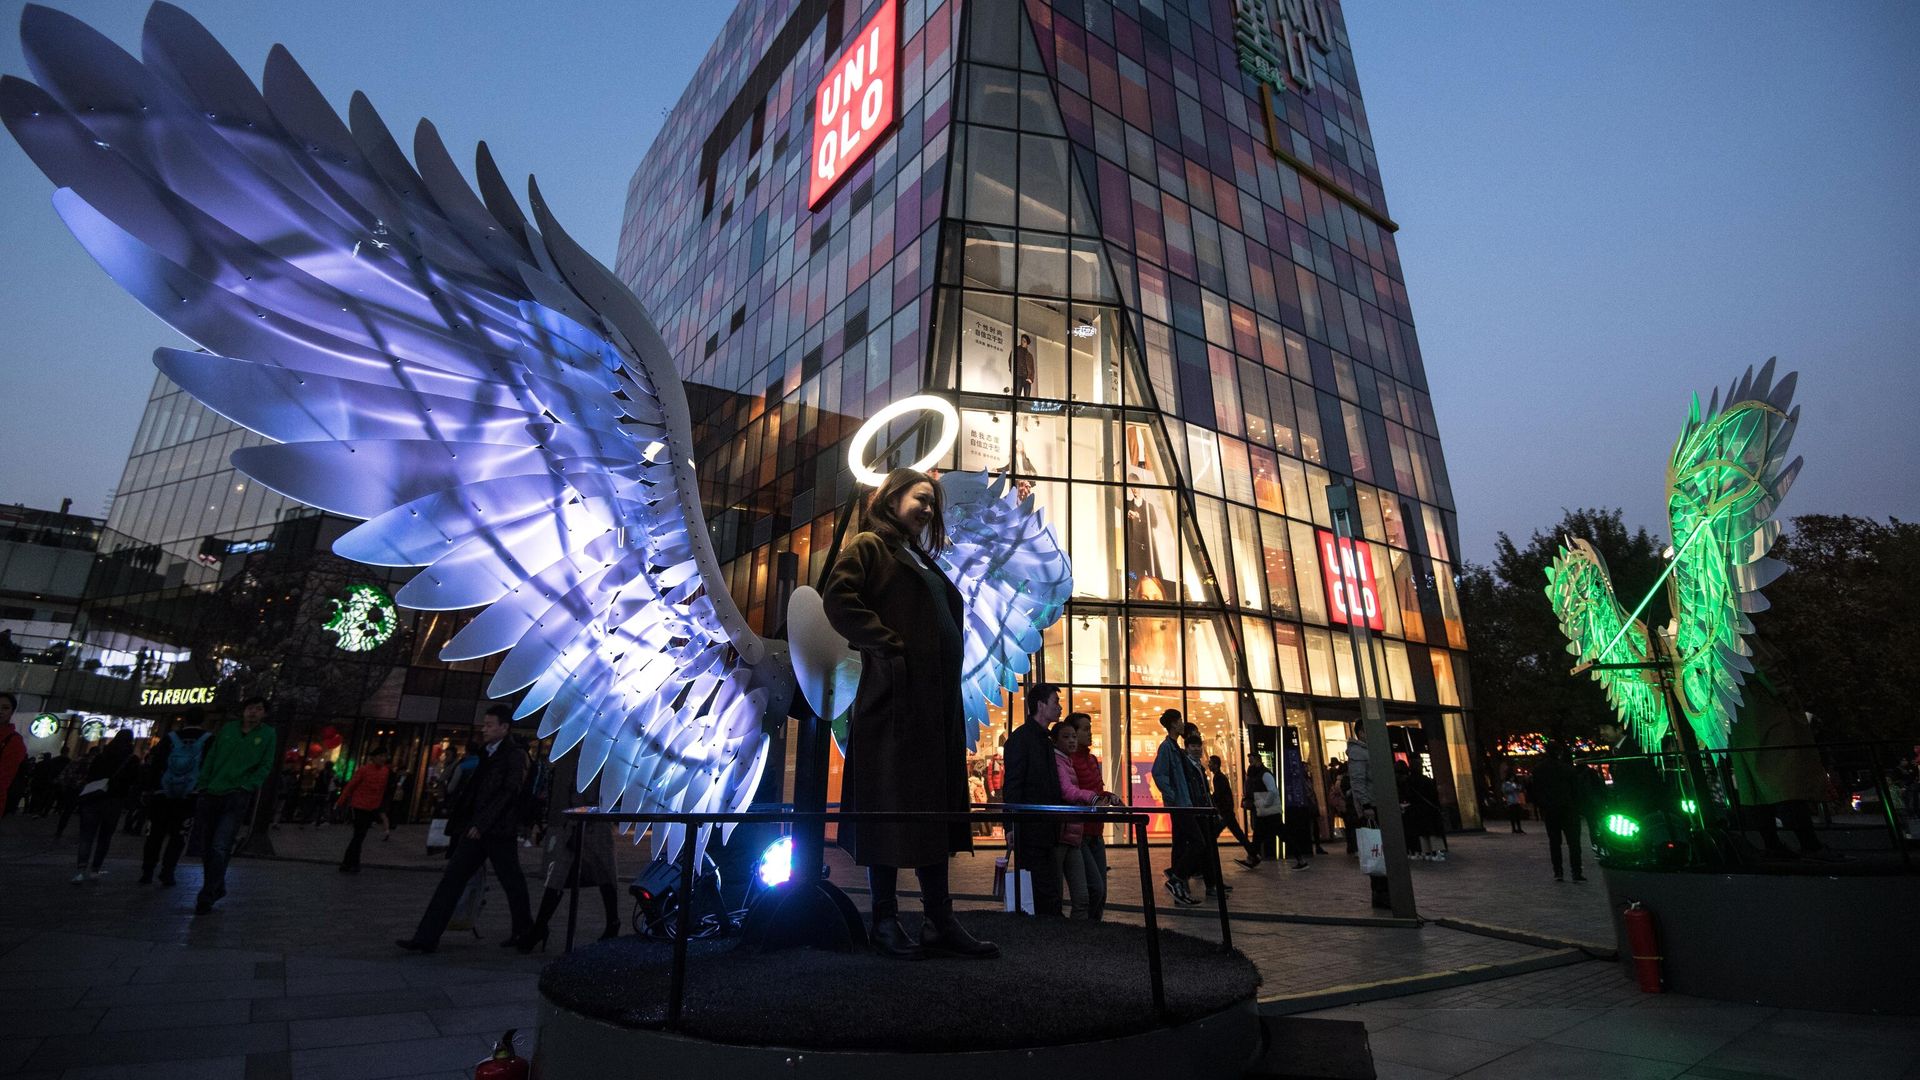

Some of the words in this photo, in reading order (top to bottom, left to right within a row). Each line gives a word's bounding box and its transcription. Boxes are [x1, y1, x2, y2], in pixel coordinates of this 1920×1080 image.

[821, 26, 880, 127] UNI
[818, 78, 883, 181] QLO
[1326, 543, 1367, 581] UNI
[140, 686, 217, 705] STARBUCKS
